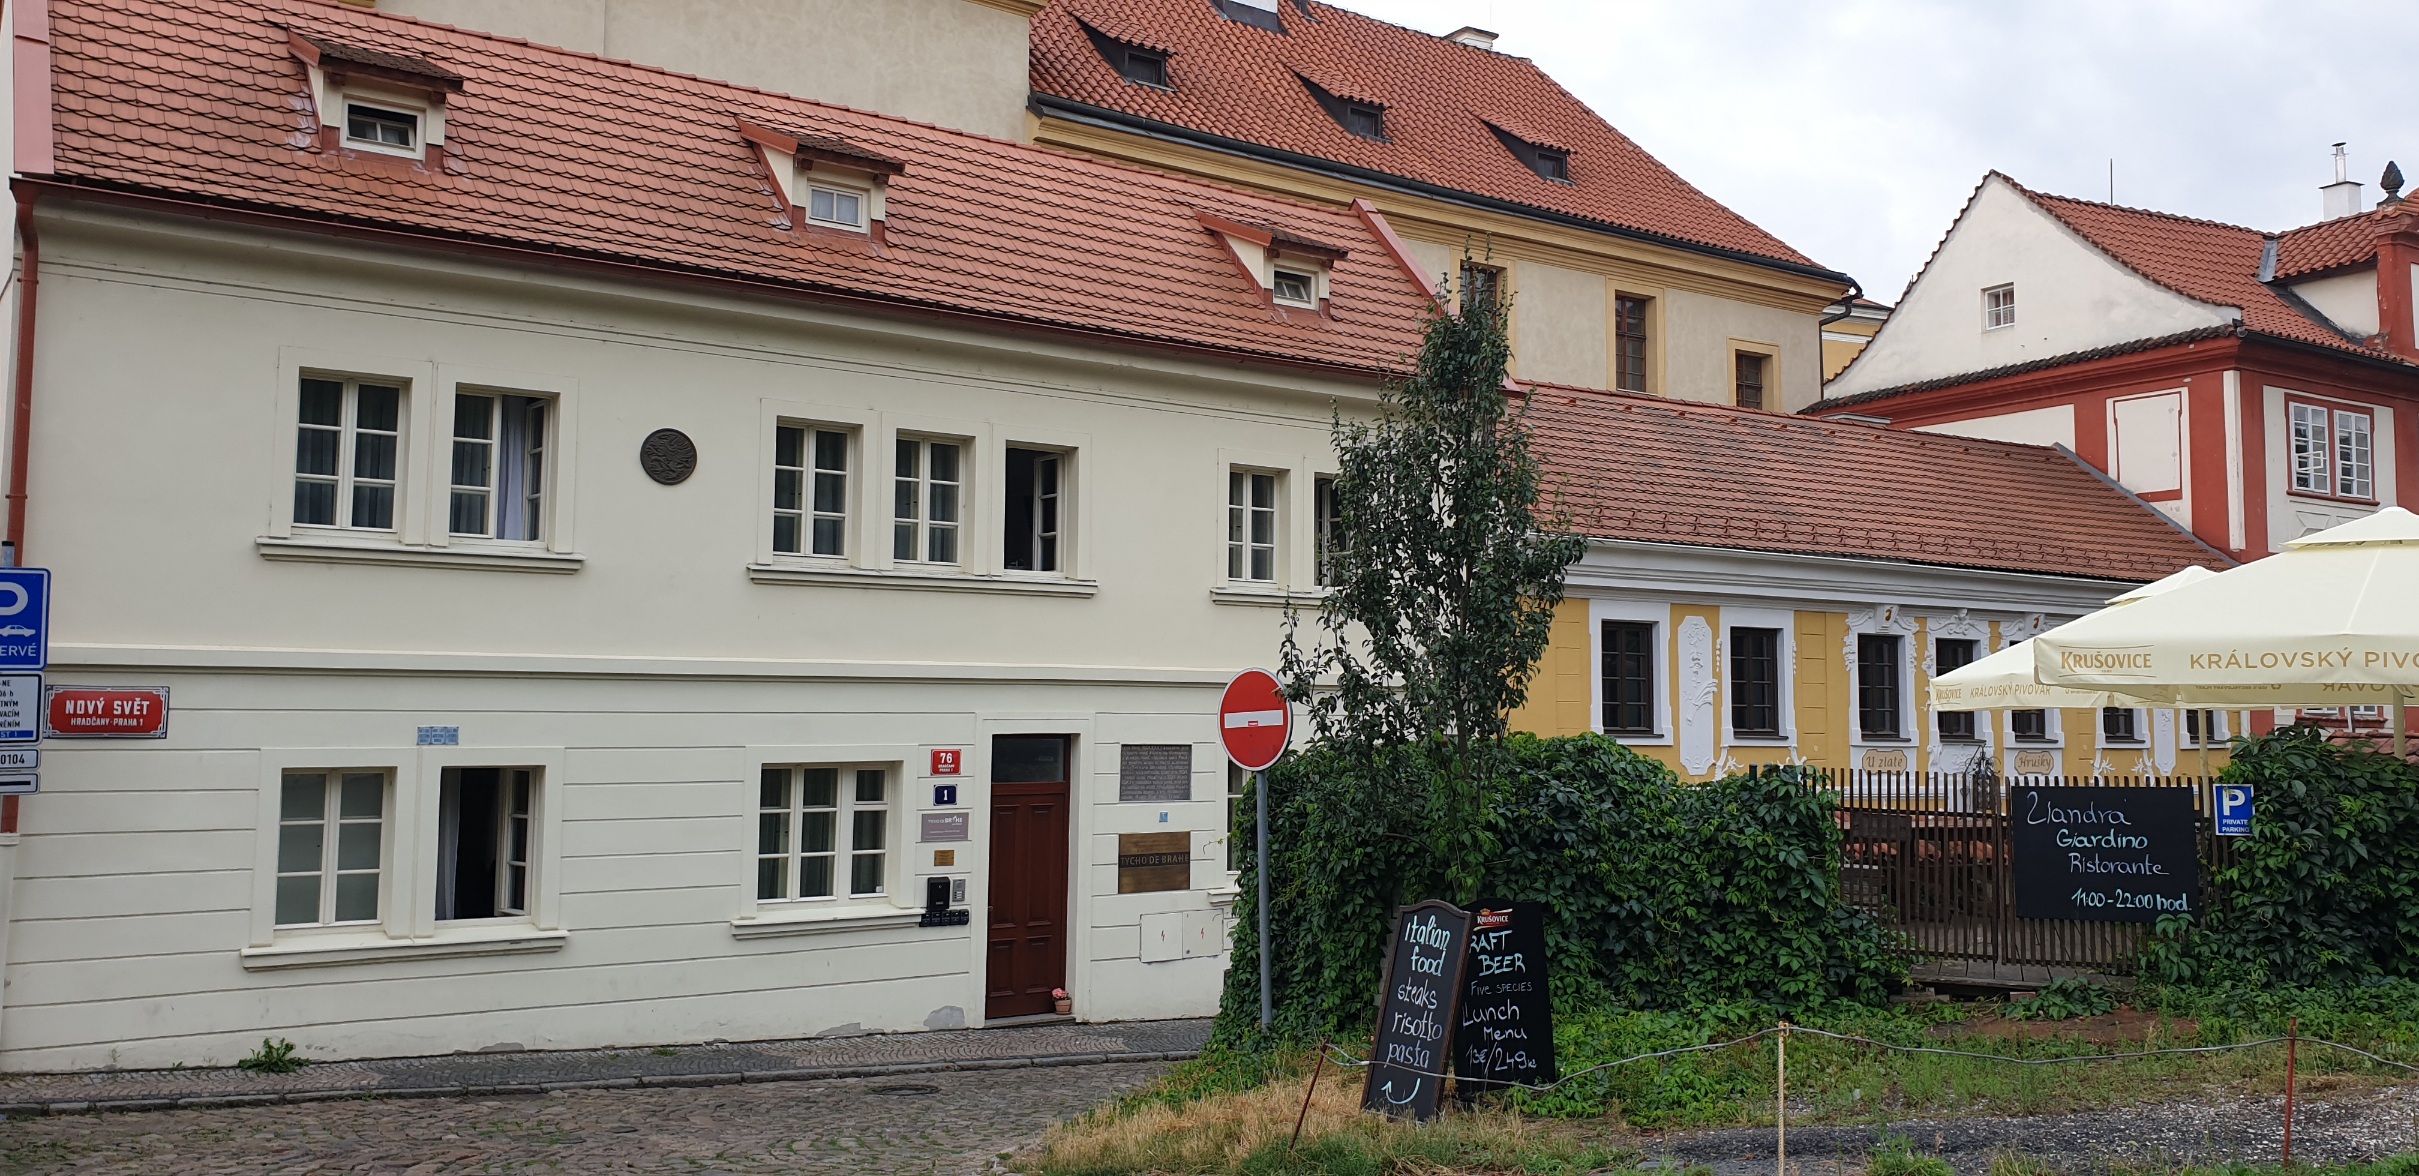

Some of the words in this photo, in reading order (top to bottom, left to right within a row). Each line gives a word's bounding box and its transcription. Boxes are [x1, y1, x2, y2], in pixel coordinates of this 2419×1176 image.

[2061, 651, 2152, 673] KRUŠOVICE
[2190, 647, 2353, 669] KRÁLOVSKÝ
[65, 697, 104, 714] NOVÝ
[113, 698, 150, 715] SVĚT
[139, 718, 144, 726] 1
[940, 752, 953, 764] 76
[1866, 756, 1876, 768] U
[943, 789, 948, 801] 1
[2222, 789, 2246, 816] P
[2057, 829, 2148, 849] Giardino
[1121, 856, 1147, 866] TYCHO
[1149, 855, 1160, 865] DE
[1161, 853, 1189, 864] BRAHE
[2068, 852, 2170, 875] Ristorante
[1411, 945, 1446, 977] food
[1477, 952, 1526, 977] BEER
[1397, 976, 1438, 1009] steaks
[1392, 1010, 1442, 1041] risotto
[1483, 1026, 1528, 1041] Menu
[1384, 1040, 1430, 1069] pasta
